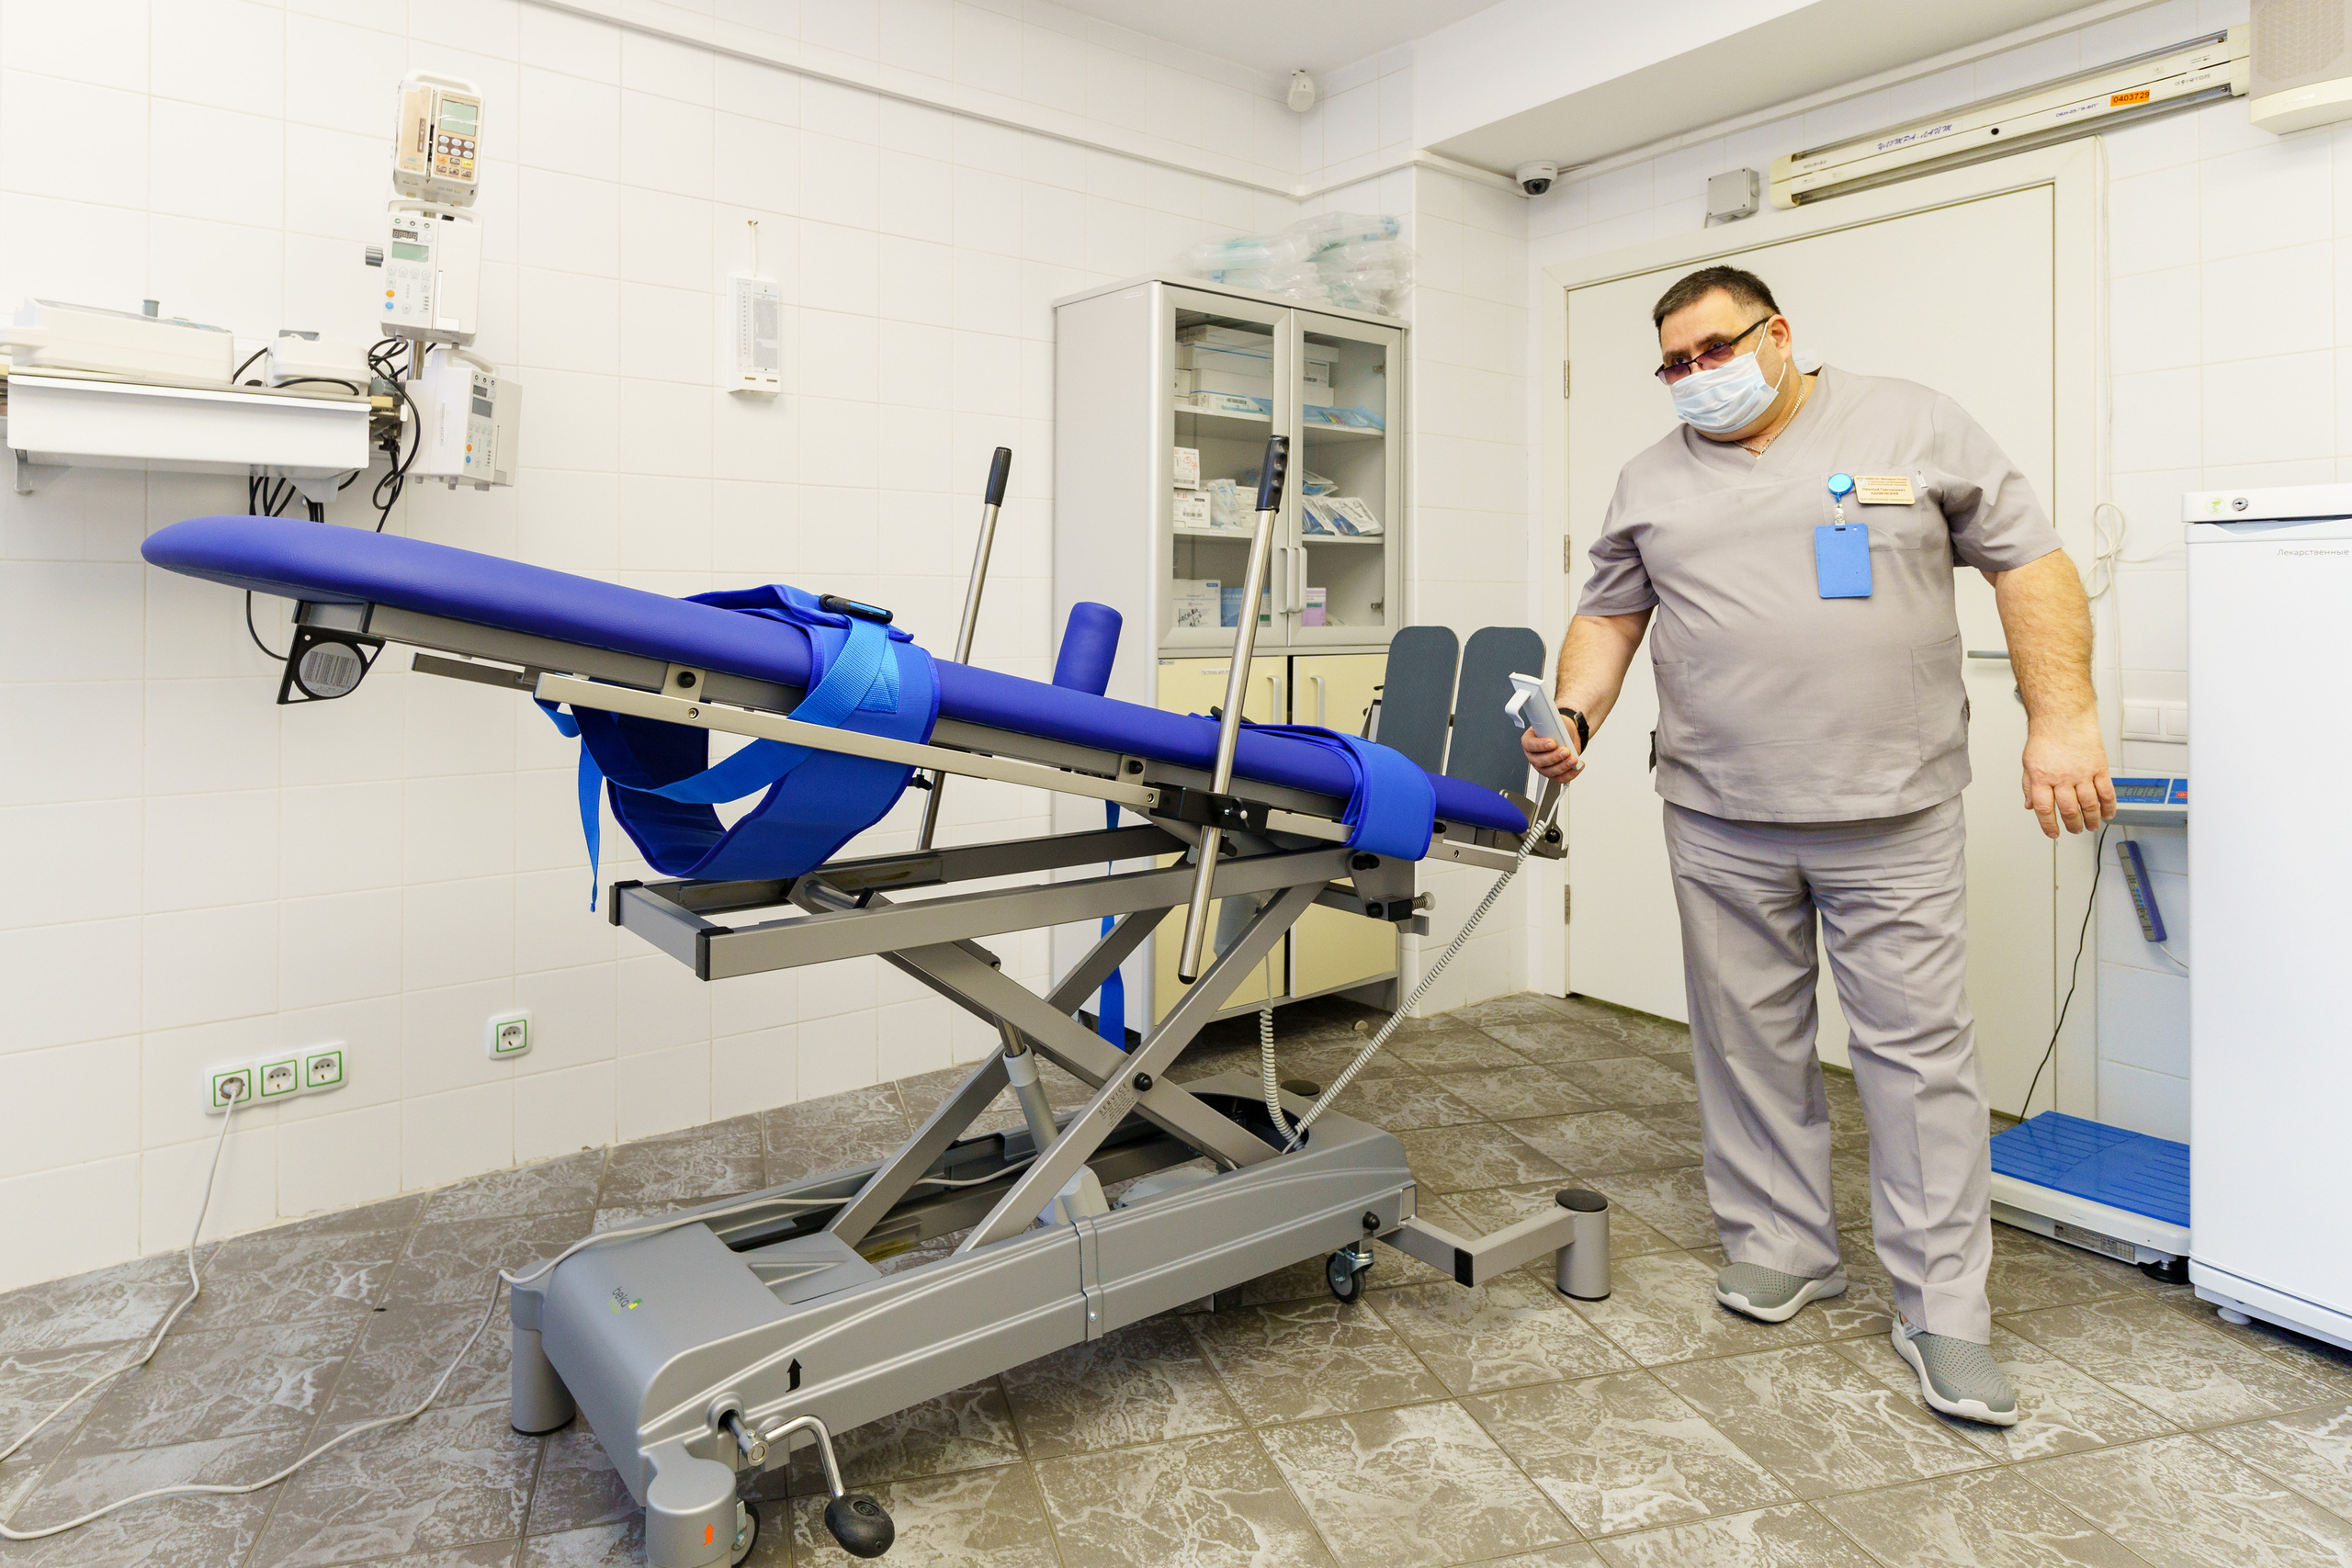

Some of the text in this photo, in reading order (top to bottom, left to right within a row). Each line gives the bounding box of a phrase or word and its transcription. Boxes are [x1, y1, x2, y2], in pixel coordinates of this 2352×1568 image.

[2113, 91, 2150, 103] 0403729
[2277, 548, 2350, 557] Лекарственные
[1099, 1082, 1127, 1115] SERVICE
[612, 1286, 629, 1308] beka
